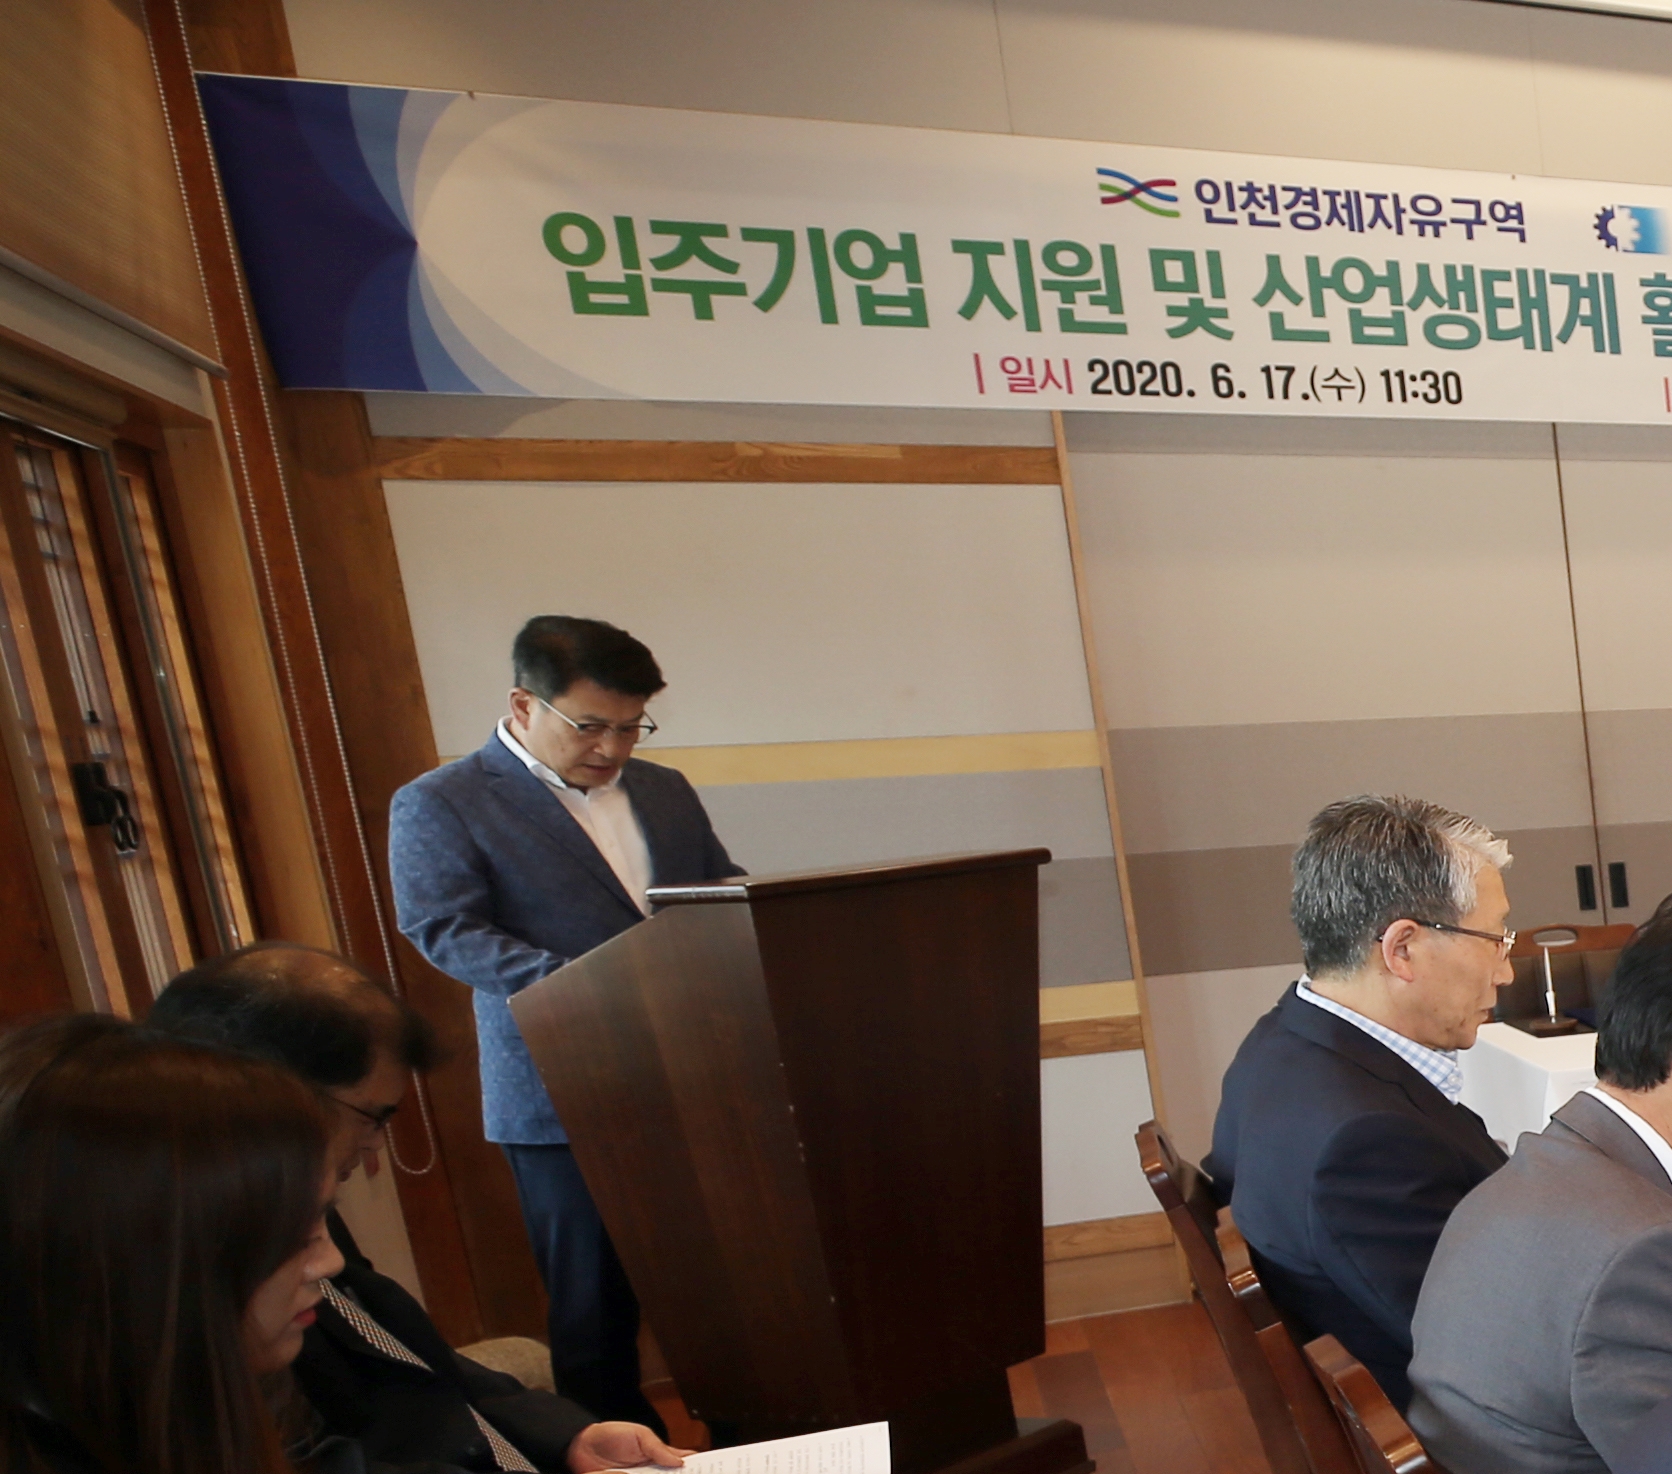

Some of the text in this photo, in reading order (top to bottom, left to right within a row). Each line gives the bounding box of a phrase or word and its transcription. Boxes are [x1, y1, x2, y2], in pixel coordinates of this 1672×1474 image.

[1193, 178, 1528, 244] 인천경제자유구역
[542, 211, 931, 329] 입주기업
[950, 238, 1130, 336] 지원
[1148, 248, 1235, 342] 및
[1251, 253, 1622, 356] 산업생태계
[999, 355, 1074, 396] 일시
[1086, 357, 1197, 399] 2020.
[1209, 362, 1248, 400] 6.
[1378, 368, 1464, 406] 11:30
